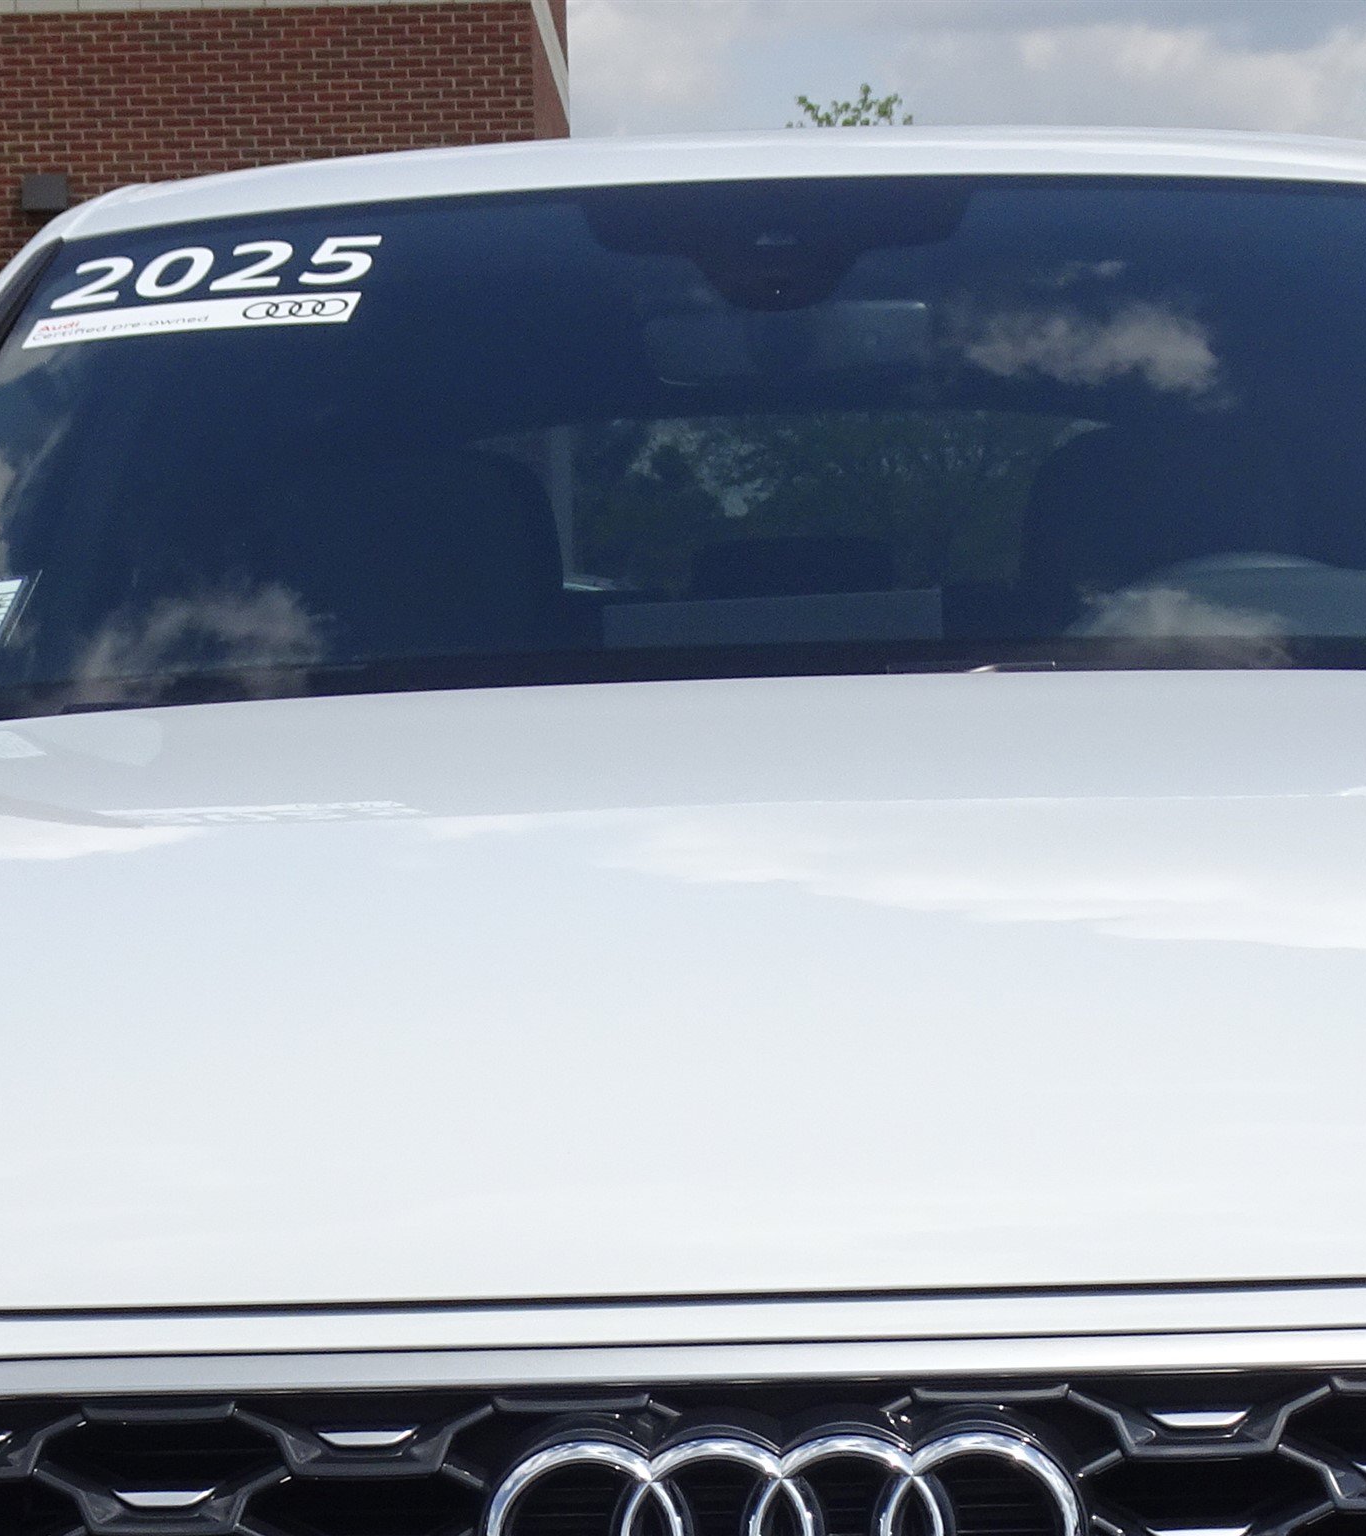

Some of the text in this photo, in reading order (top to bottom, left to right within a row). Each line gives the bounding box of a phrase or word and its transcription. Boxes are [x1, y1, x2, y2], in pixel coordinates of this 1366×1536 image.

[50, 235, 382, 310] 2025
[39, 320, 81, 333] Audi
[110, 314, 210, 332] pre-owned
